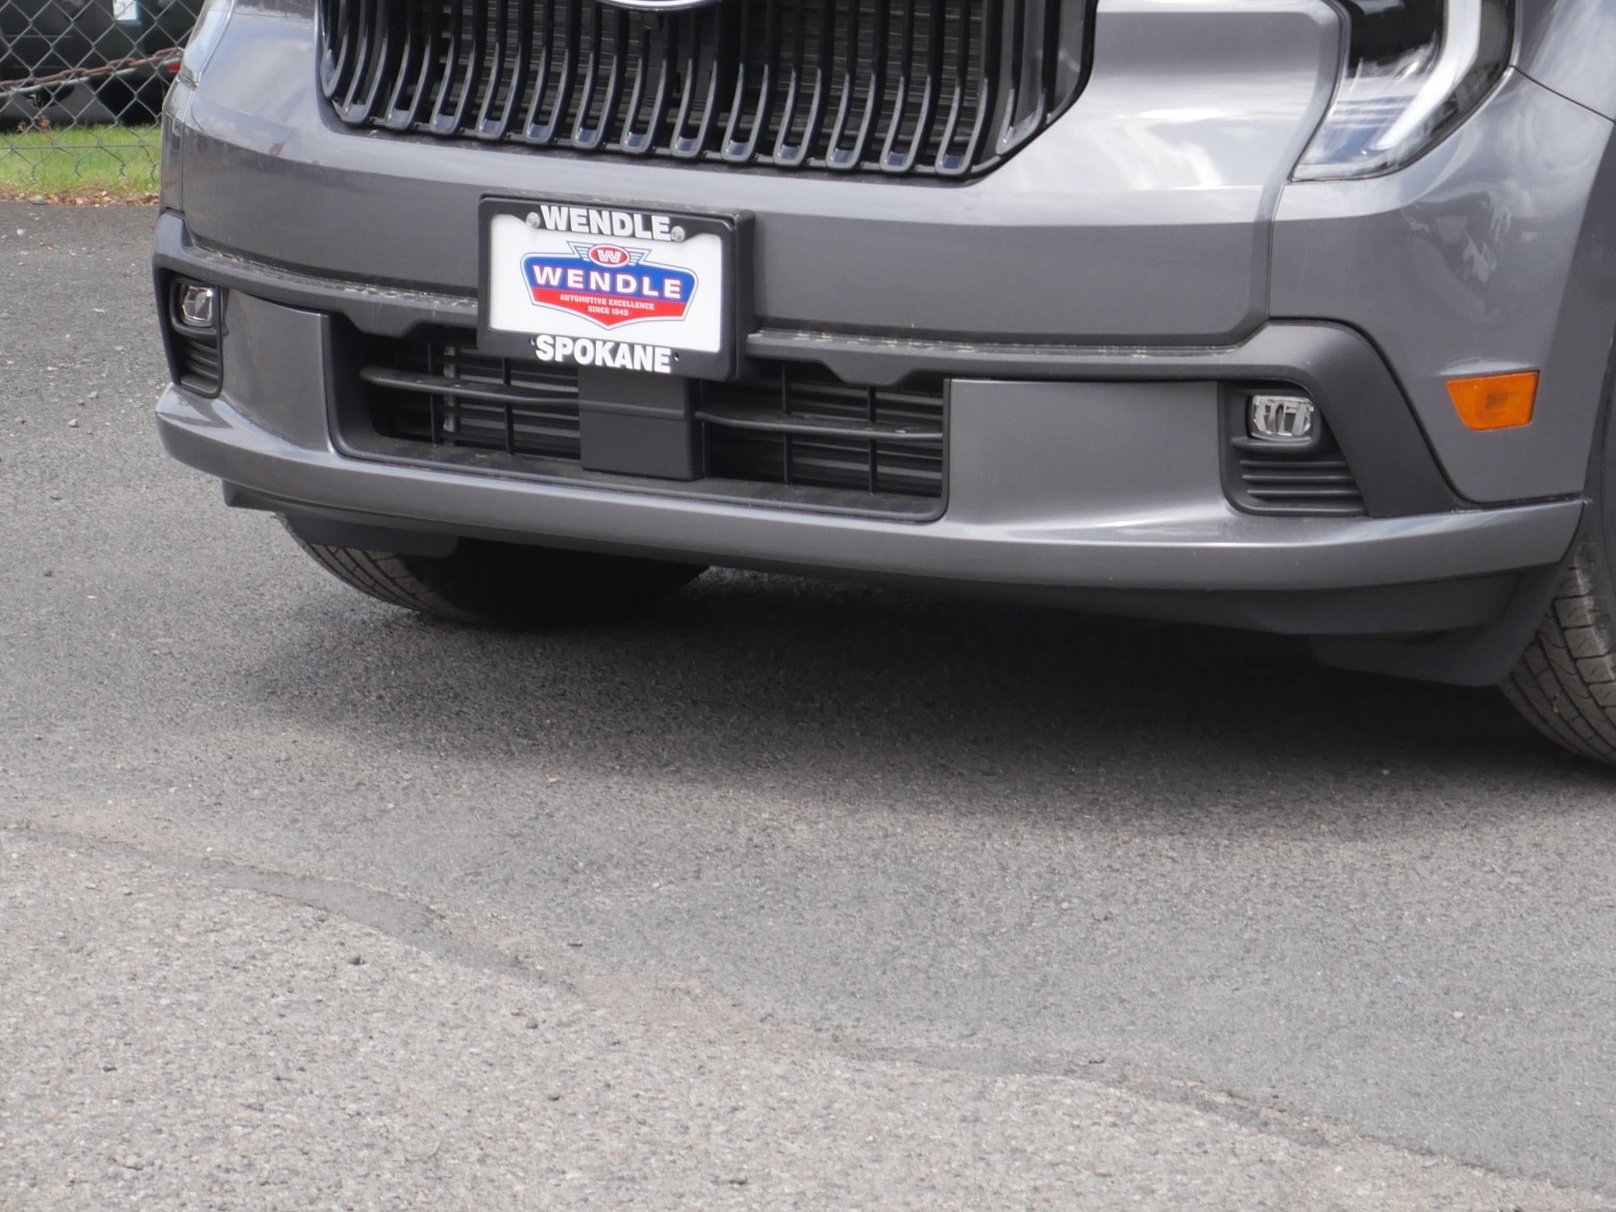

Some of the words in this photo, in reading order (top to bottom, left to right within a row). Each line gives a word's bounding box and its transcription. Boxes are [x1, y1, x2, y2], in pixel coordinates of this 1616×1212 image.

[541, 206, 671, 240] WENDLE
[533, 266, 681, 298] WENDLE
[560, 294, 607, 305] AUTOMOTIVE
[608, 298, 655, 310] EXCELLENCE
[588, 305, 610, 315] SINCE
[535, 335, 672, 374] SPOKANE
